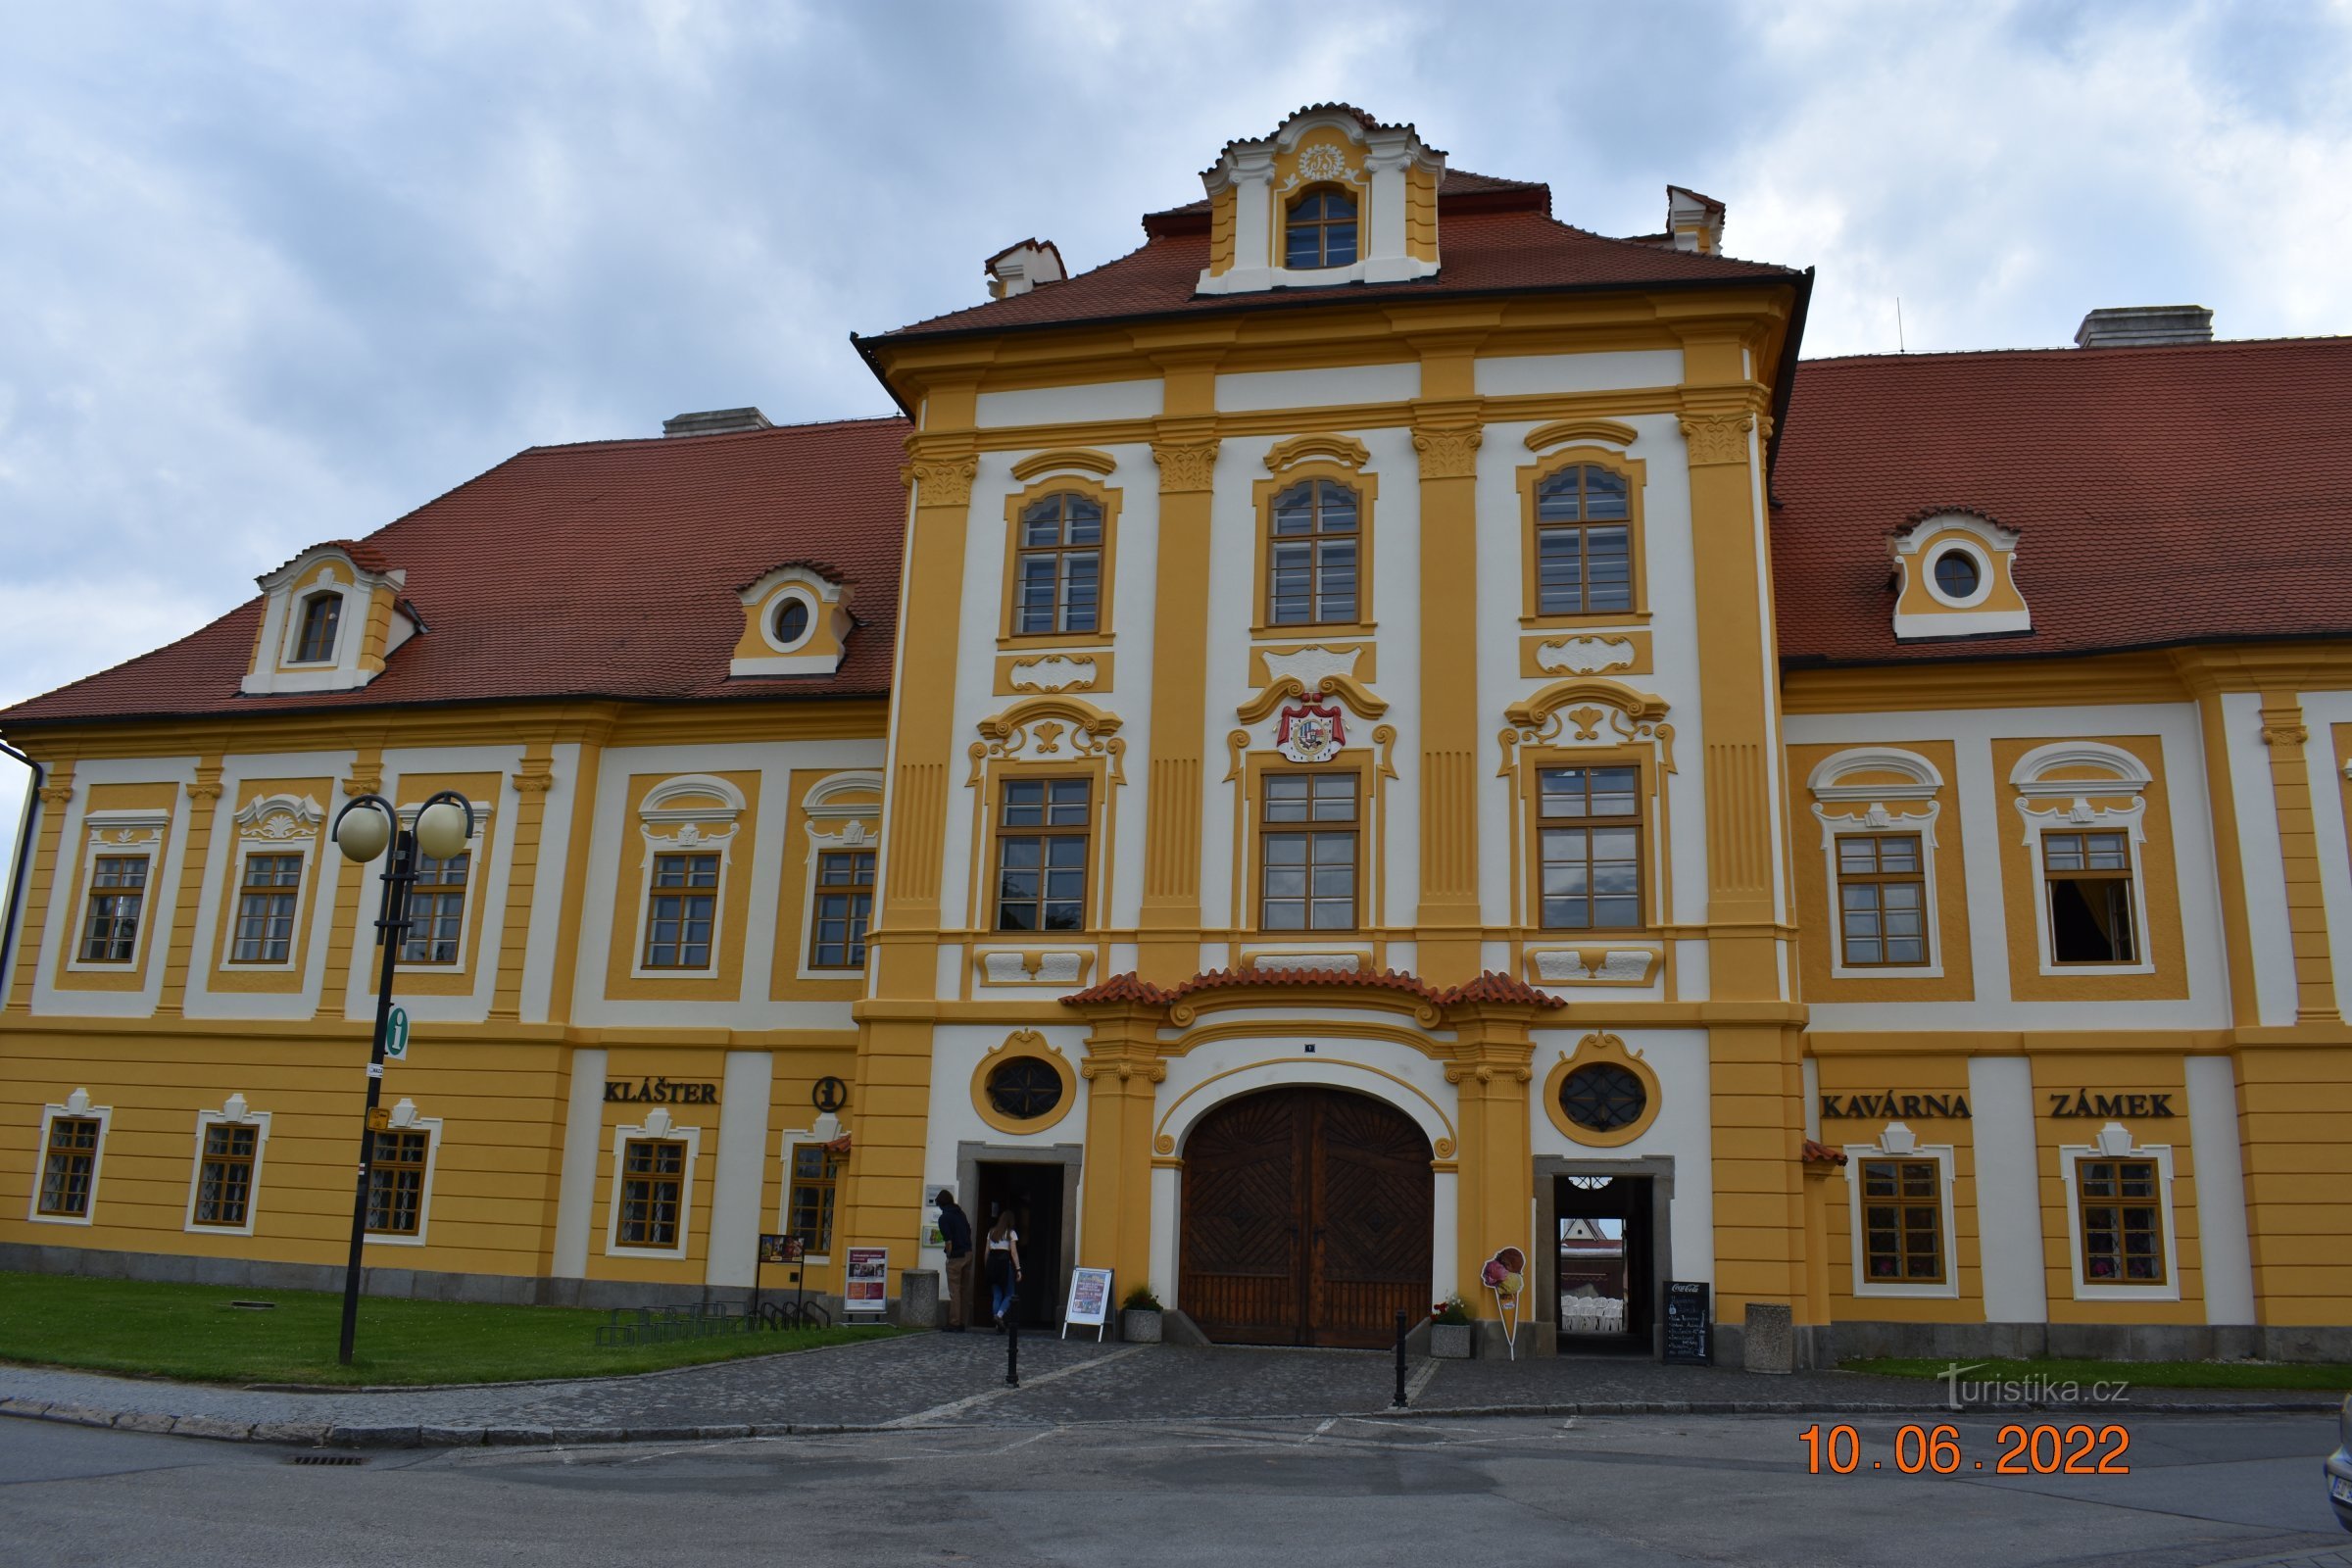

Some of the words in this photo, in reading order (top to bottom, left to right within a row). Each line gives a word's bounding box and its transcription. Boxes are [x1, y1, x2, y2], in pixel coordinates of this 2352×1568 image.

[392, 1010, 403, 1050] i
[603, 1077, 716, 1103] KLÁŠTER
[821, 1080, 837, 1106] i
[1821, 1089, 1973, 1118] KAVÁRNA
[2050, 1088, 2174, 1117] ZÁMEK
